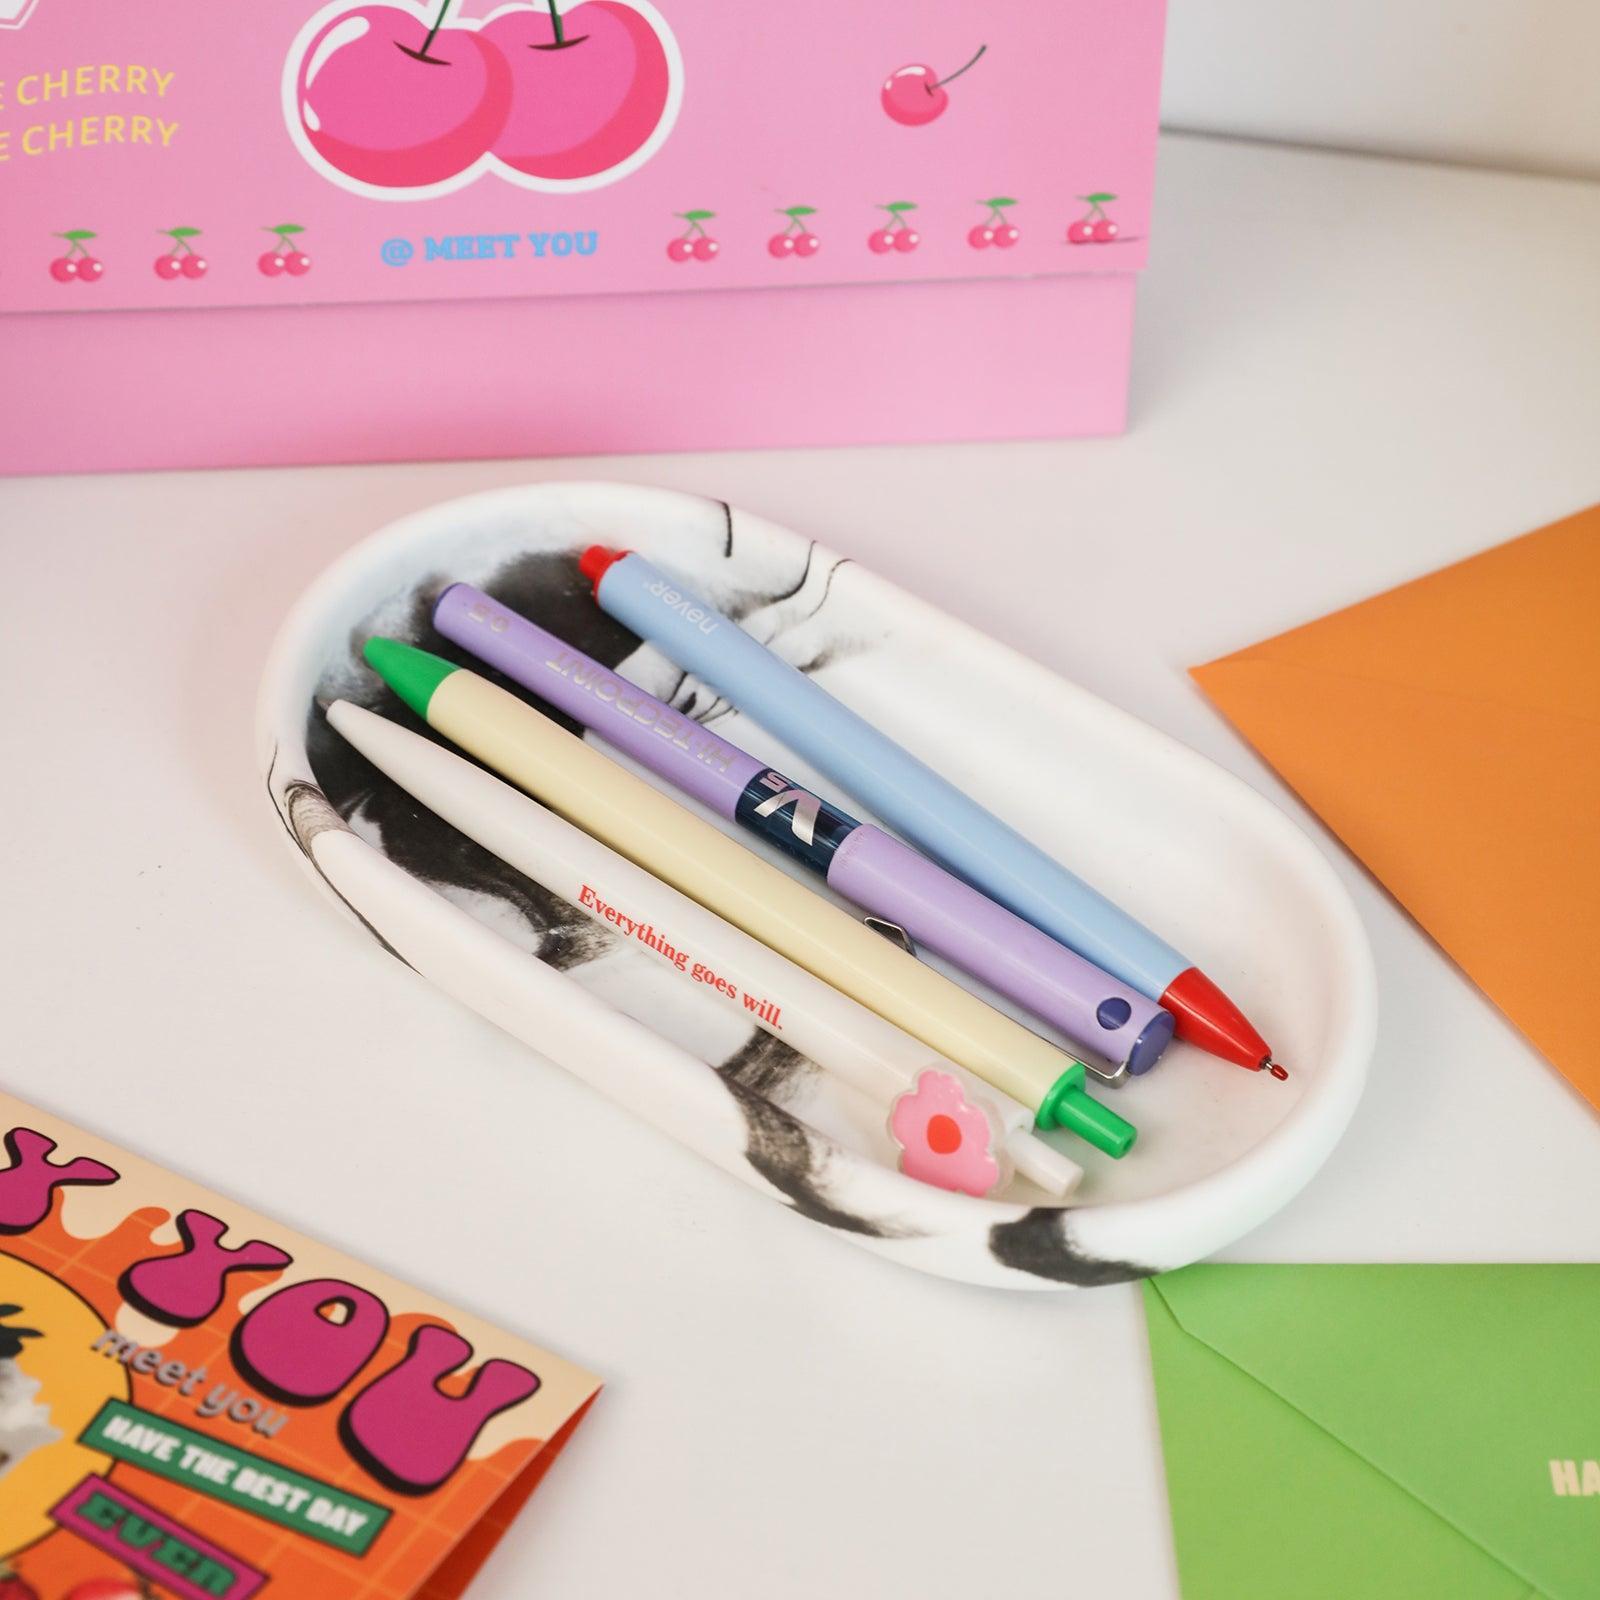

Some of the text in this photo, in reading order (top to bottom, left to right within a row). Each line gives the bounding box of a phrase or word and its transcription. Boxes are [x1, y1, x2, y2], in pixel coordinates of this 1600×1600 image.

[16, 63, 175, 106] CHERRY
[22, 114, 179, 156] CHERRY
[424, 233, 521, 261] MEET
[527, 231, 598, 257] YOU
[578, 884, 784, 1030] Everything goes will.
[91, 1329, 289, 1438] meet you
[118, 1209, 541, 1496] YOU
[102, 1415, 368, 1537] HAVE THE BEST DAY
